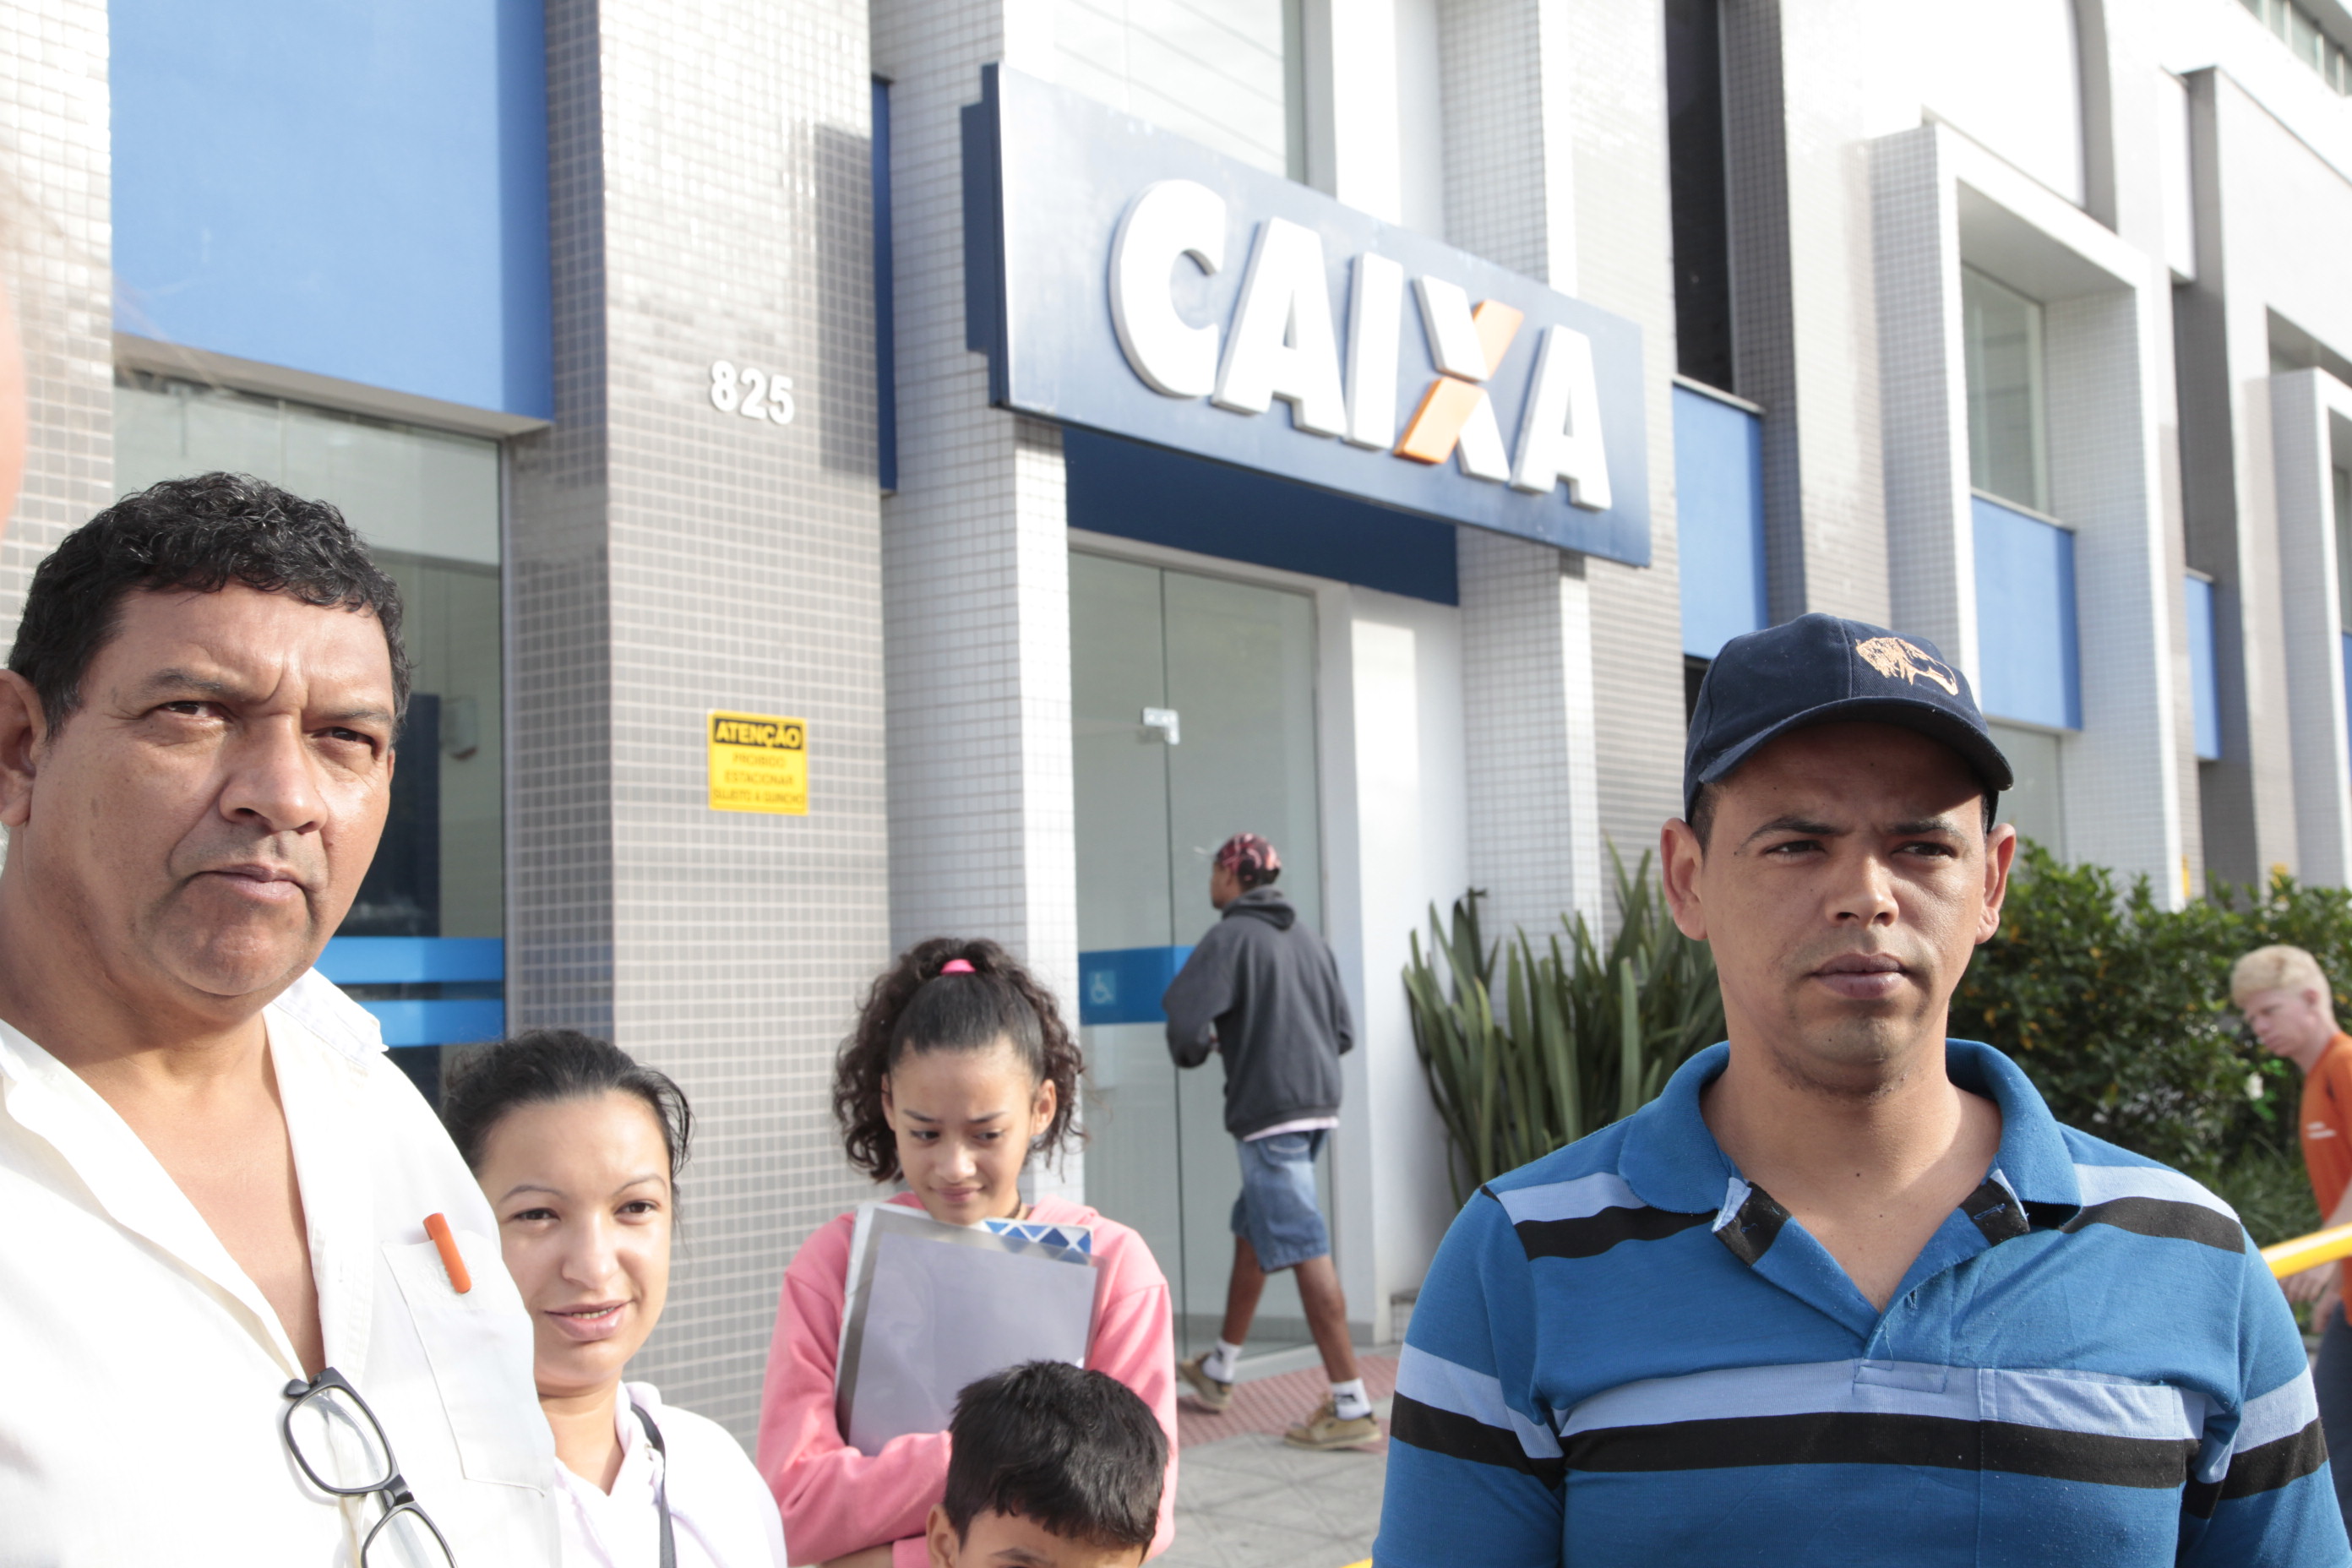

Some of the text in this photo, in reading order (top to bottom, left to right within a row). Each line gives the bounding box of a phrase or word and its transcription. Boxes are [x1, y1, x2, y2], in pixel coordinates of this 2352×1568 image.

[1108, 178, 1612, 511] CAIXA
[710, 359, 795, 425] 825
[716, 720, 802, 749] ATENÇÃO
